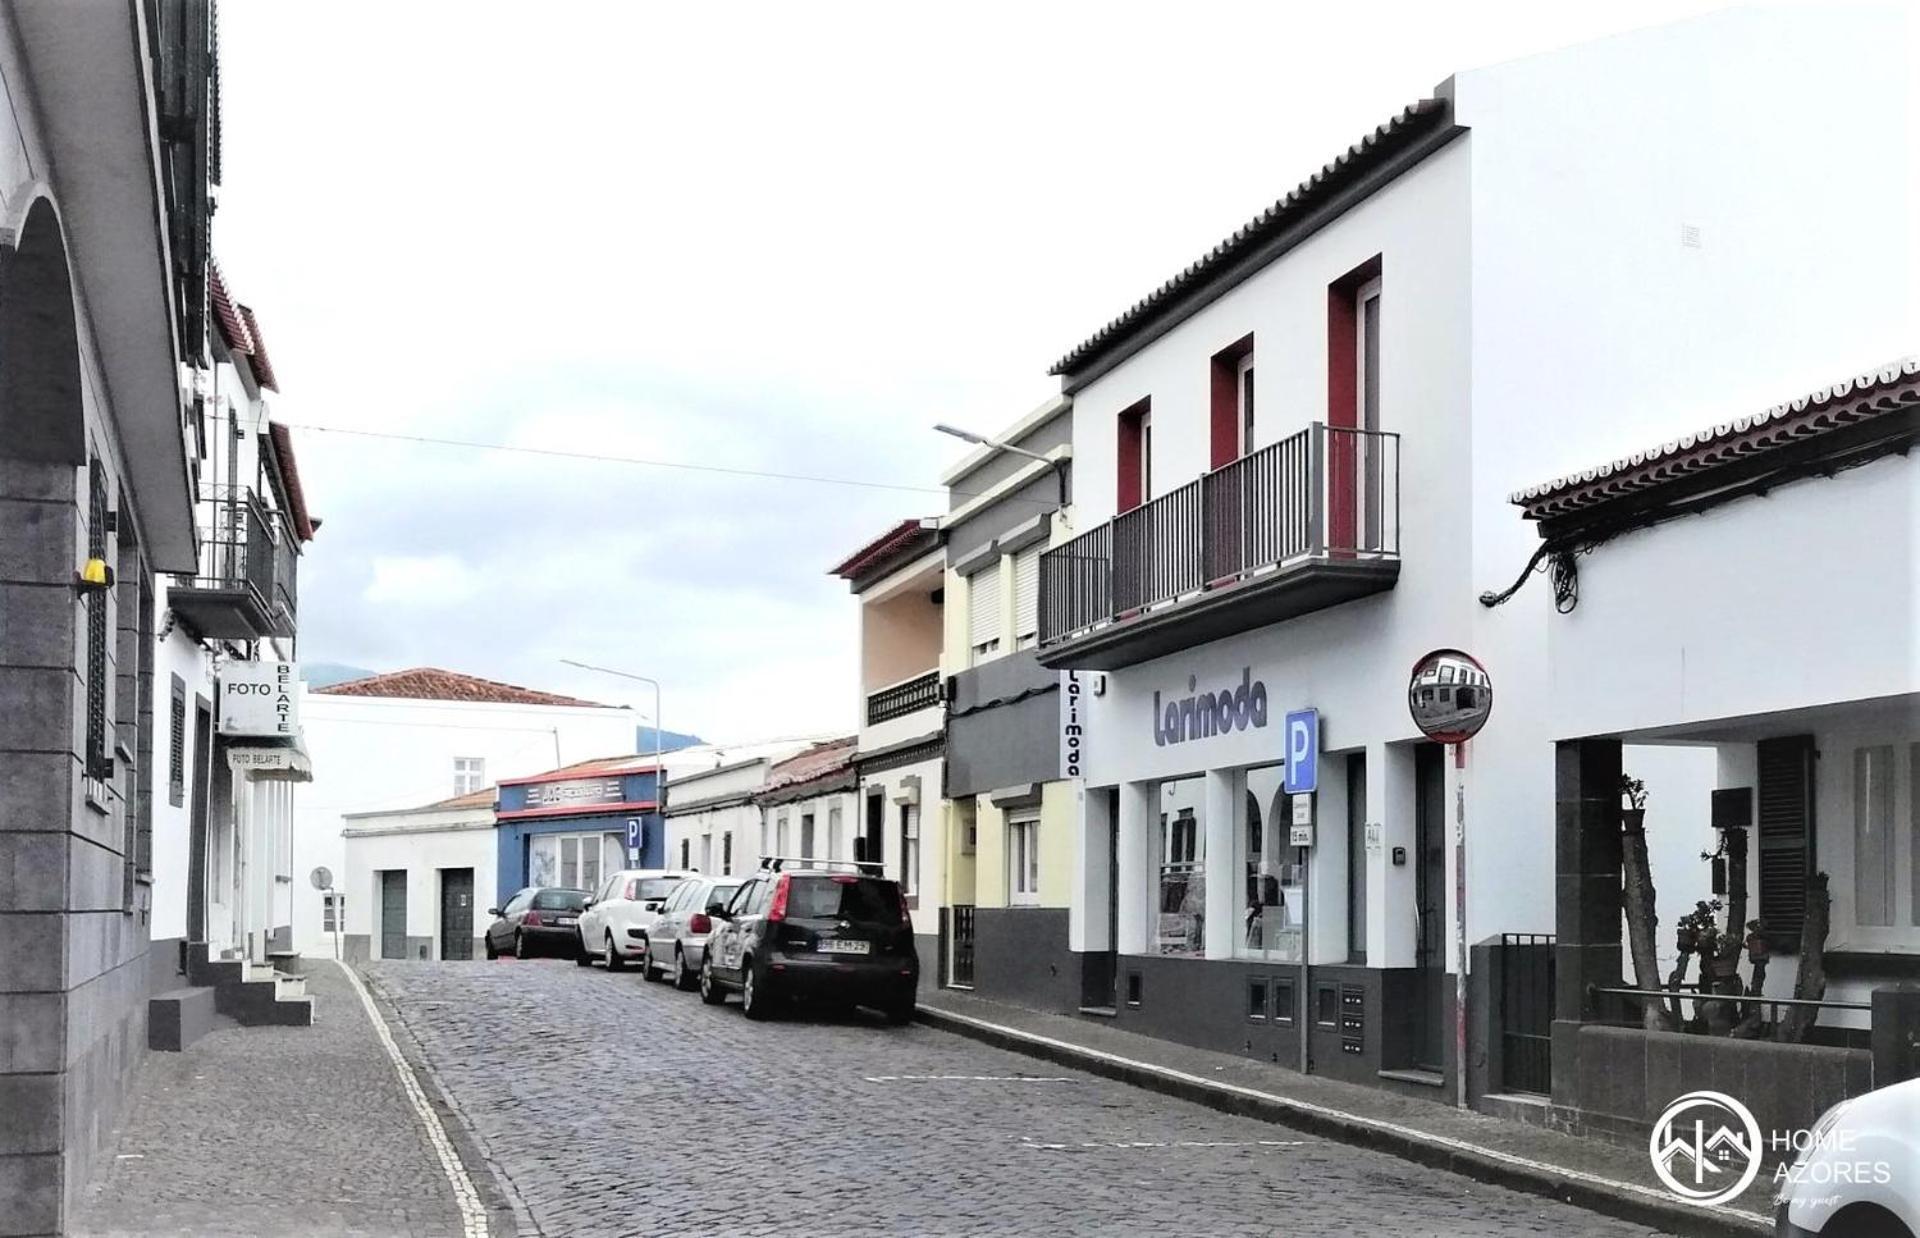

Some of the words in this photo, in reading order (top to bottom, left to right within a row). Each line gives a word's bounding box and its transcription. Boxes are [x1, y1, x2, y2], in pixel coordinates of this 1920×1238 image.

[228, 683, 271, 695] FOTO
[277, 665, 290, 732] BELARTE
[1154, 666, 1267, 747] Larimoda
[1065, 669, 1082, 777] Larimoda
[1291, 720, 1309, 786] P
[629, 820, 638, 846] P
